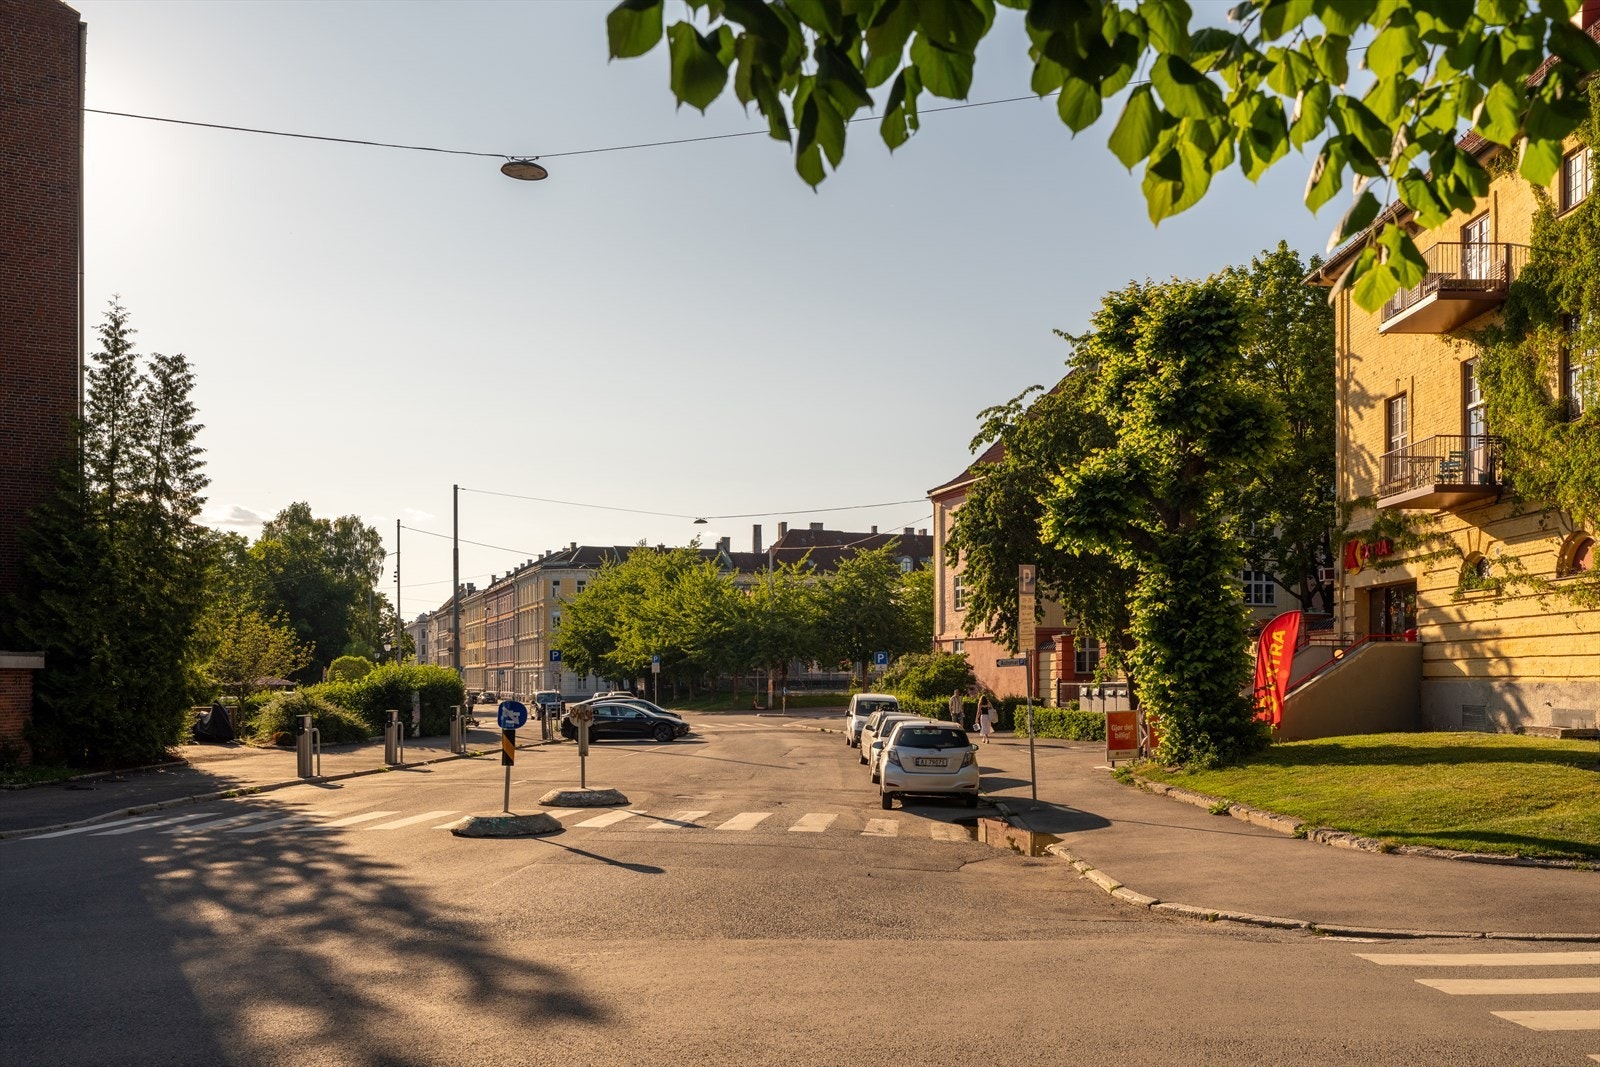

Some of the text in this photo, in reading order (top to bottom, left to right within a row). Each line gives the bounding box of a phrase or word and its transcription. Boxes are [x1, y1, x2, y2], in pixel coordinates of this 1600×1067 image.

[1022, 568, 1031, 592] P
[552, 651, 560, 661] P
[877, 653, 885, 664] P
